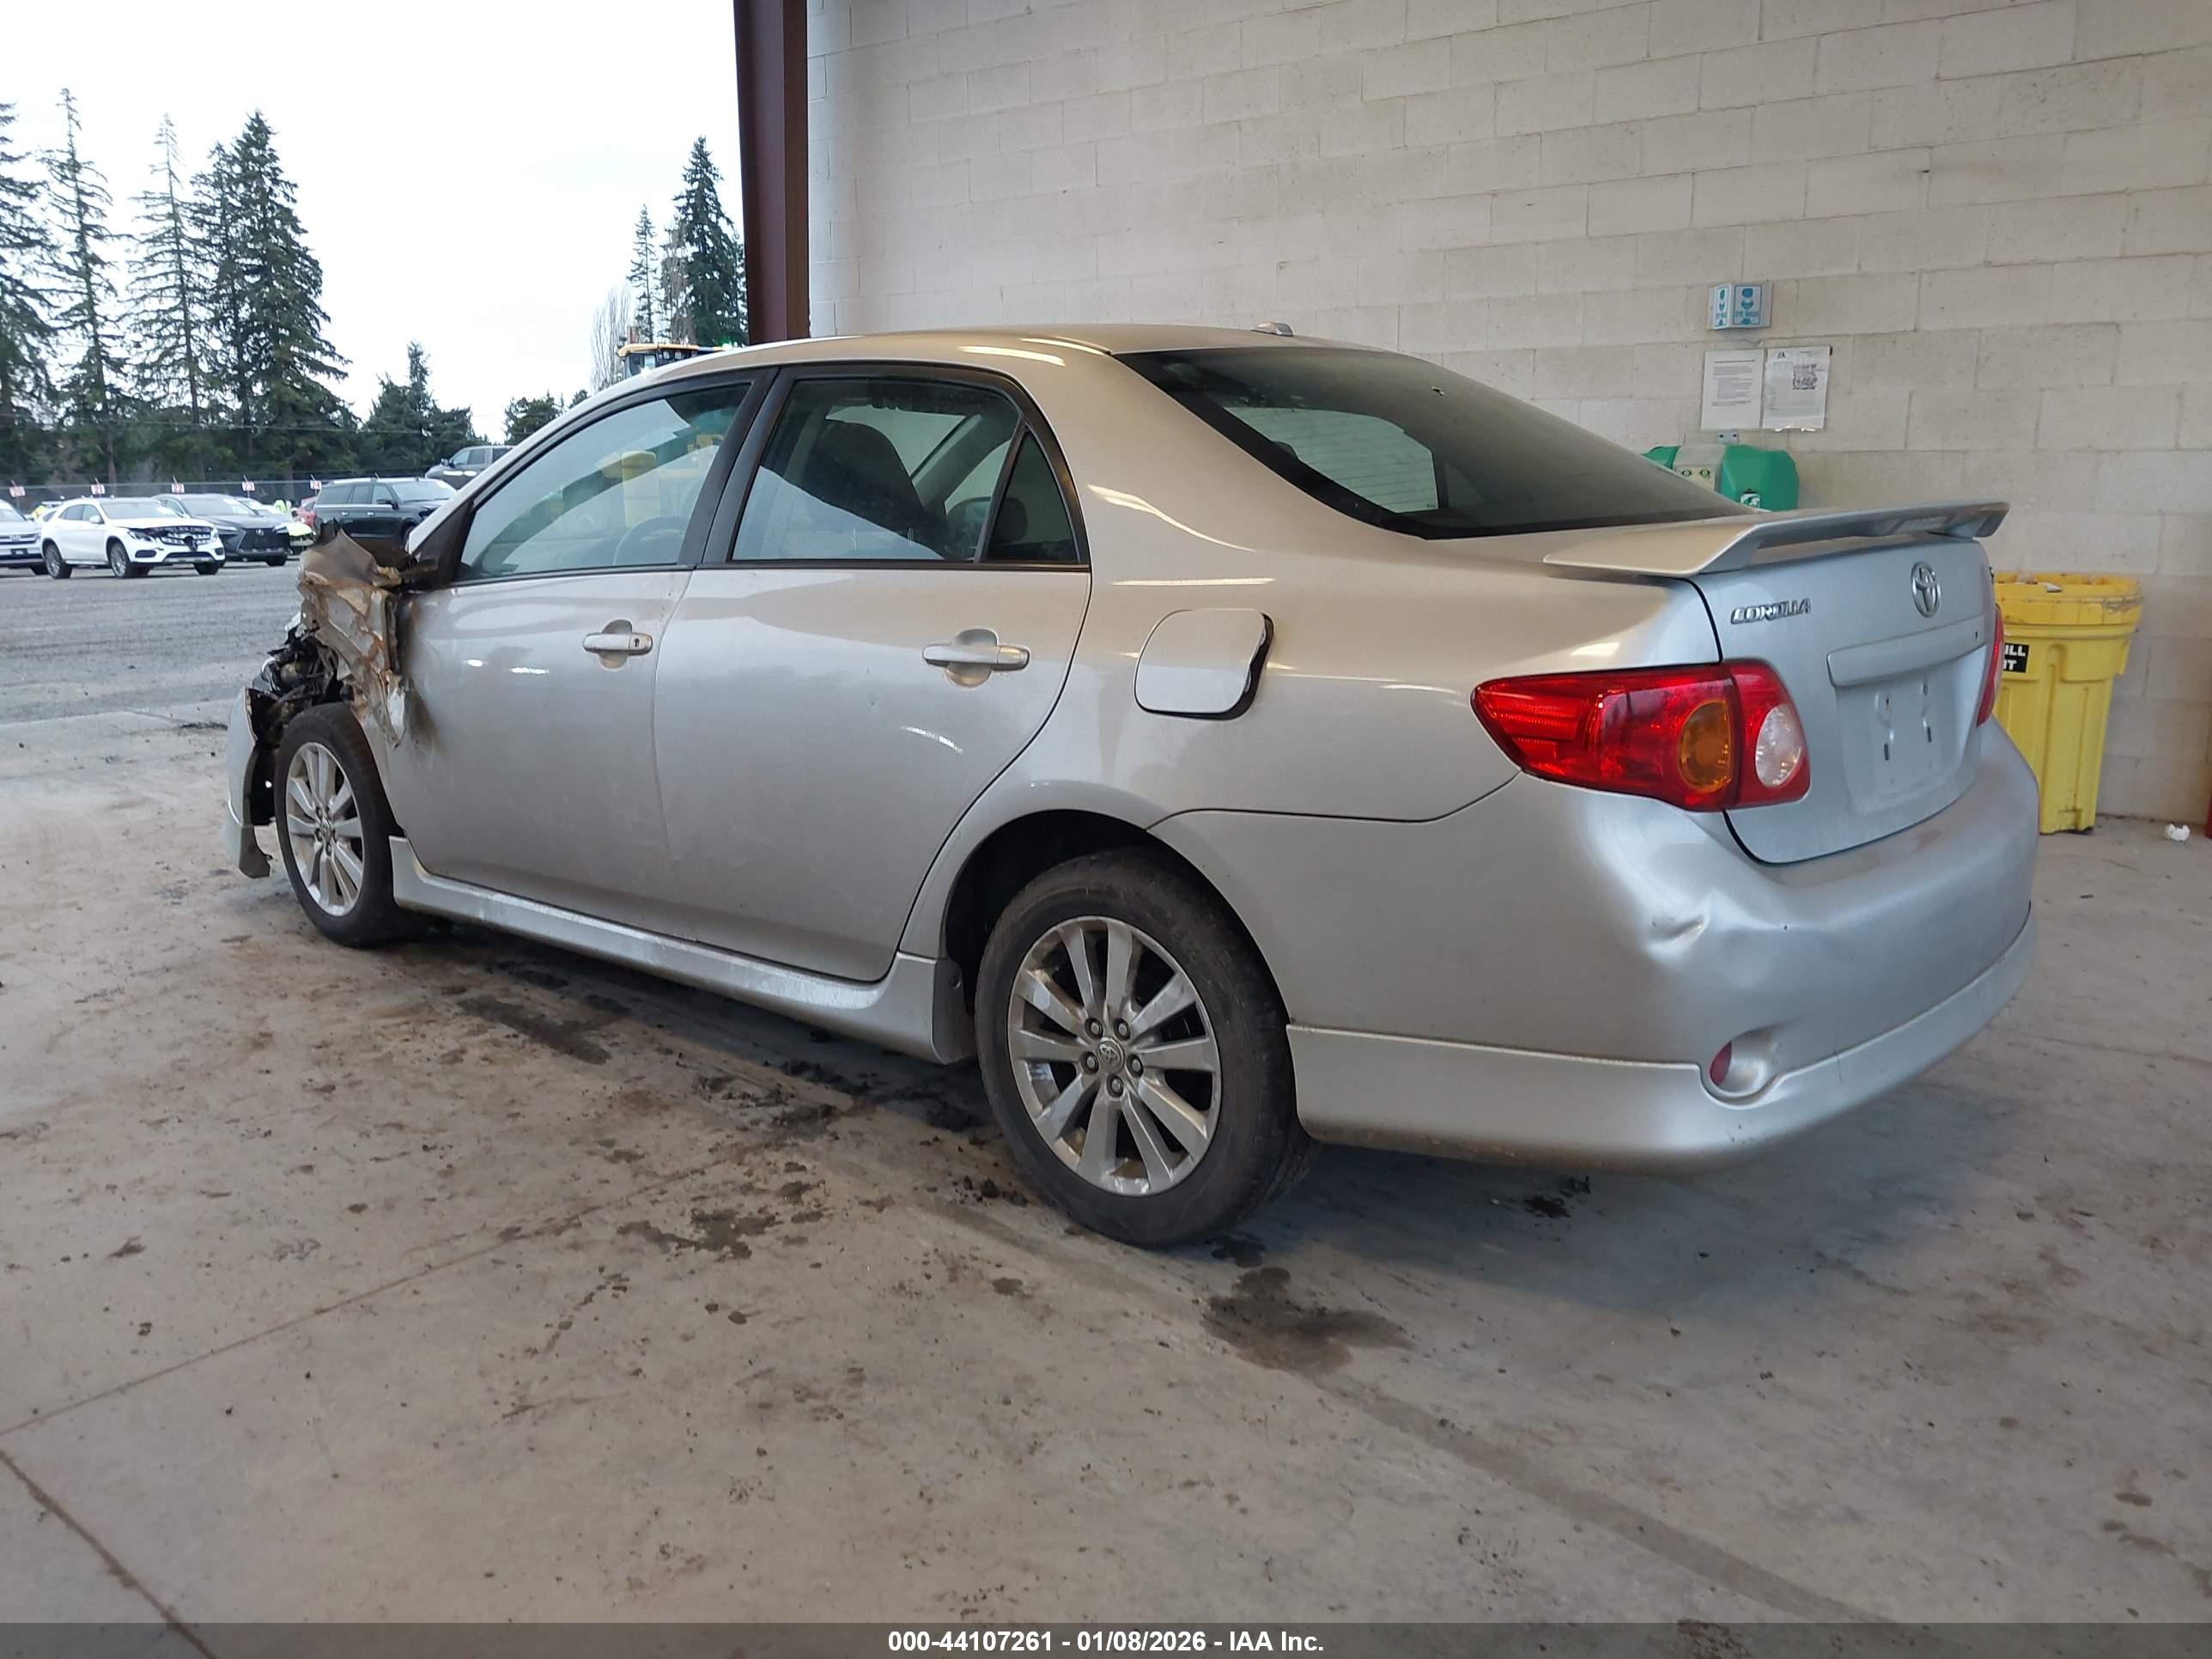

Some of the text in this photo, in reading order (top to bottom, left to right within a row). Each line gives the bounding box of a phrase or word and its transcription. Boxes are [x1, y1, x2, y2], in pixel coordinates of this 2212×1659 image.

[1730, 598, 1811, 624] COROLLA
[2005, 645, 2027, 657] ILL
[2003, 659, 2017, 671] IT
